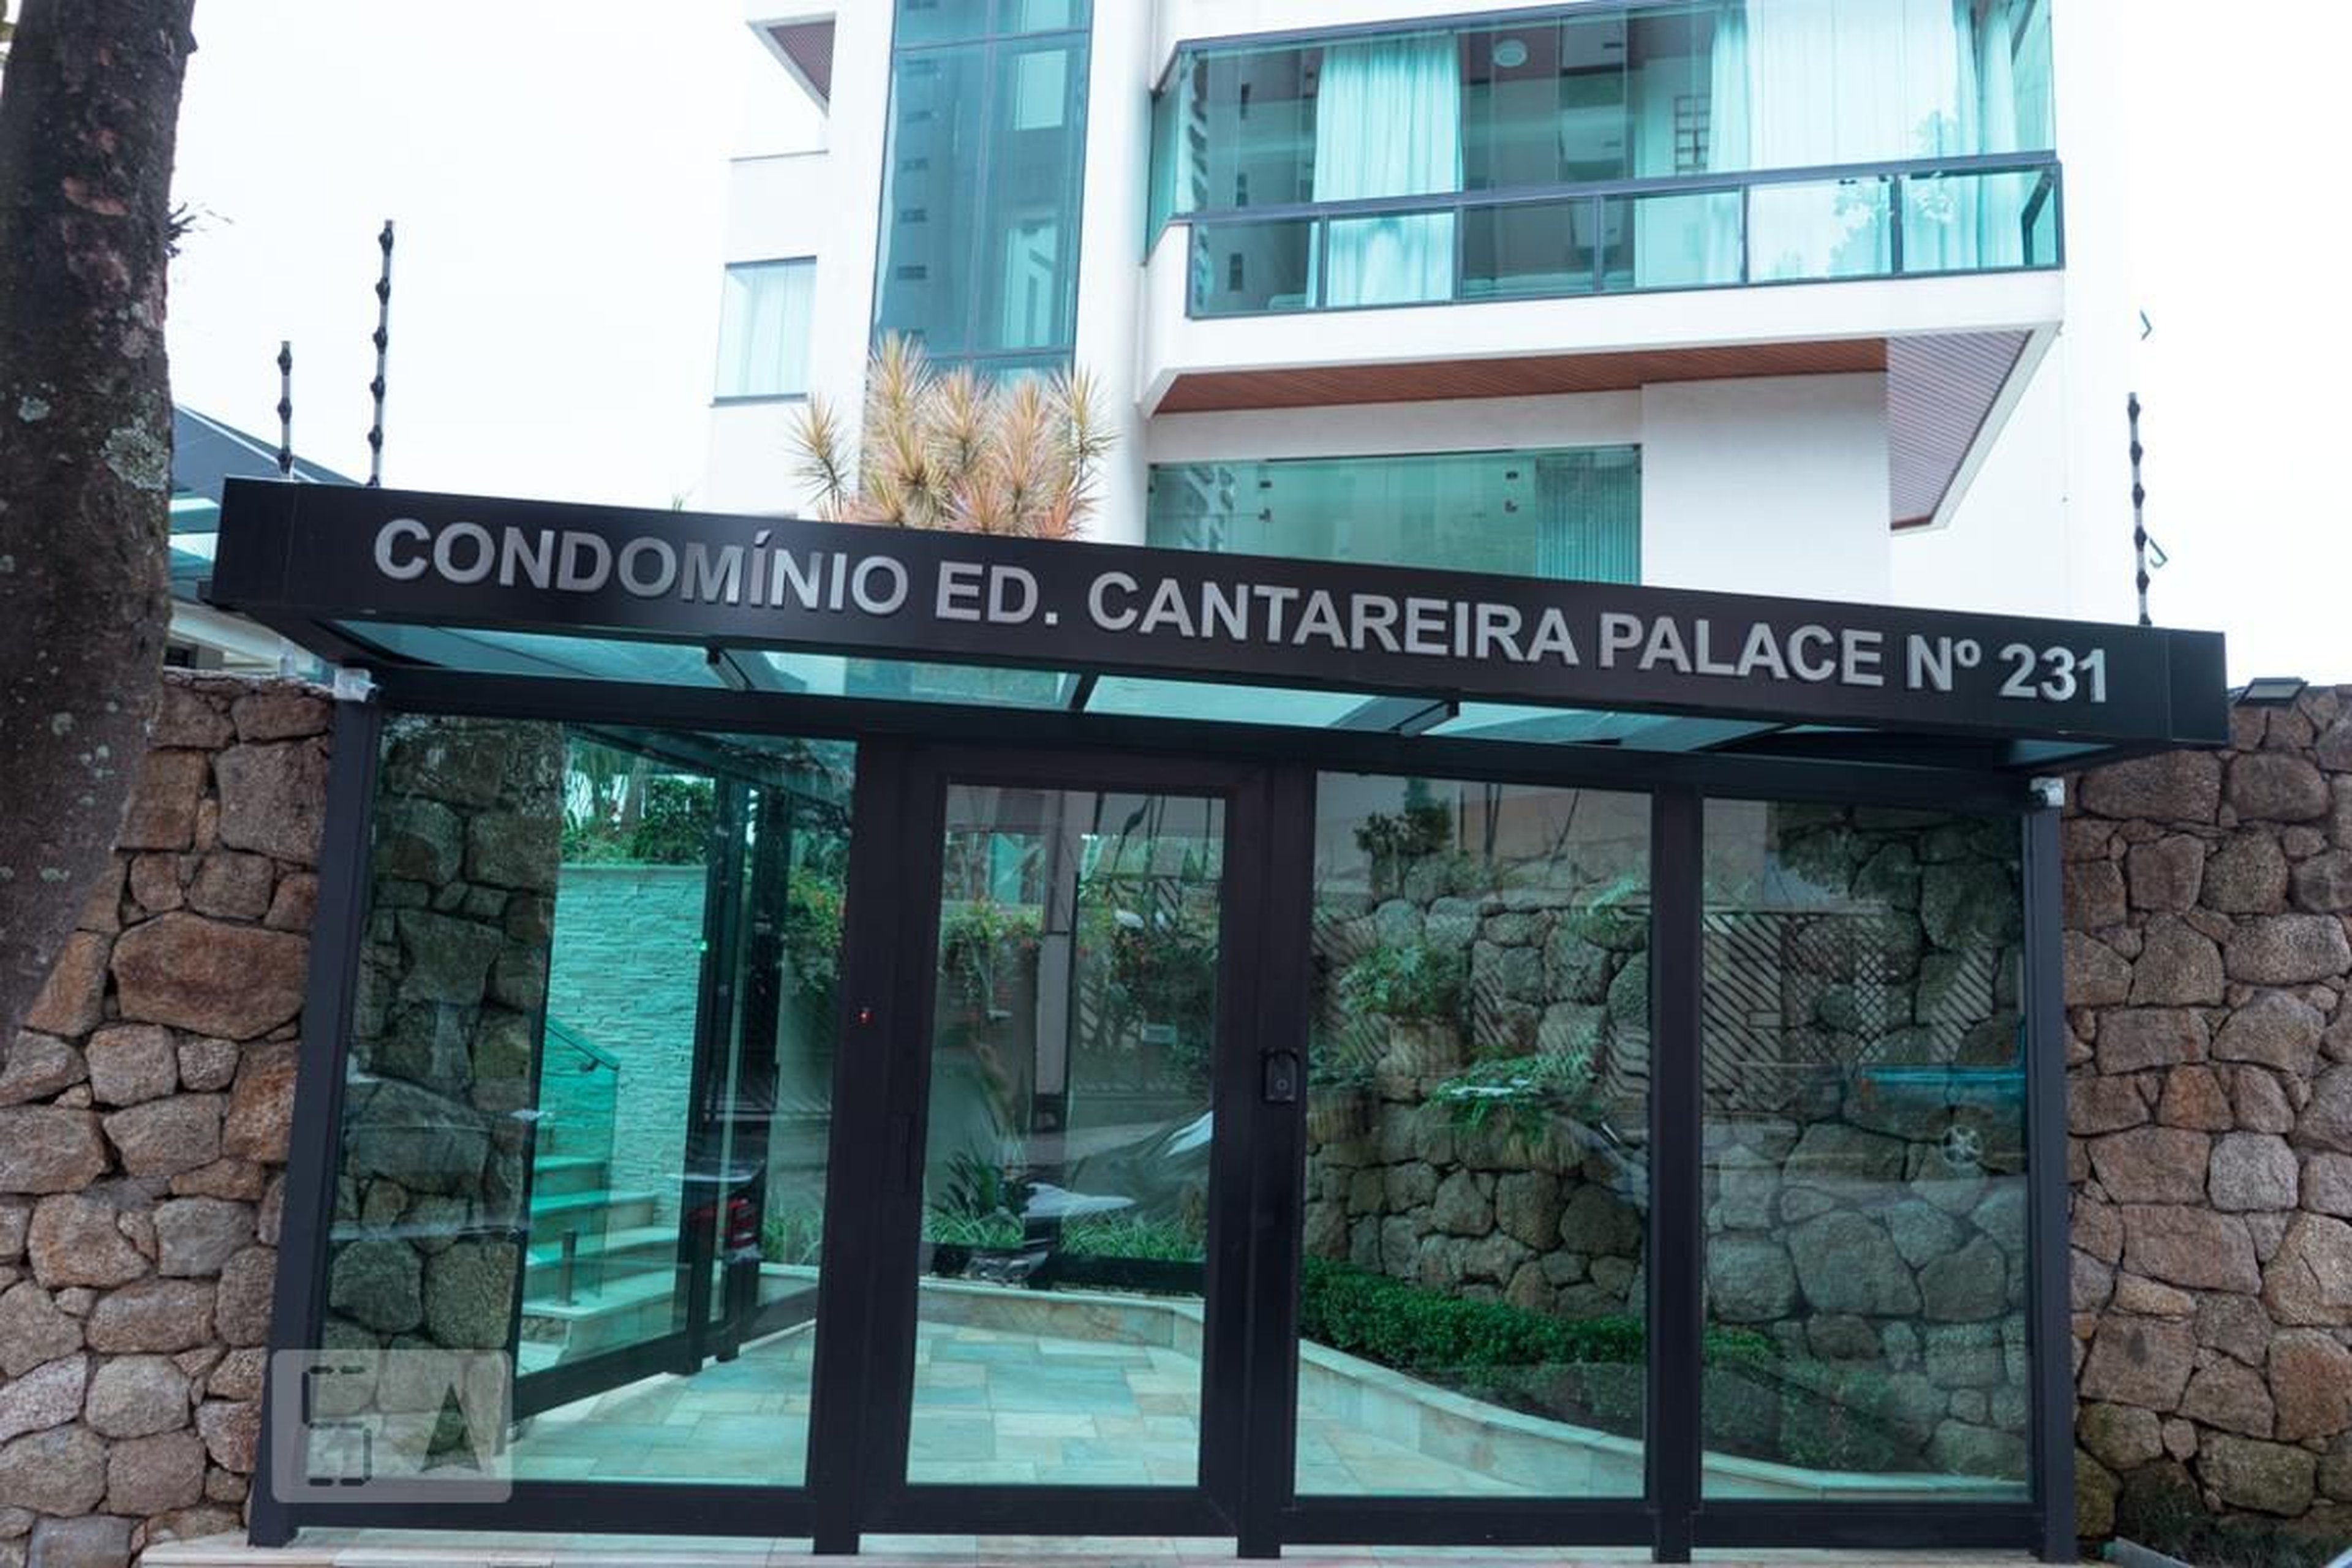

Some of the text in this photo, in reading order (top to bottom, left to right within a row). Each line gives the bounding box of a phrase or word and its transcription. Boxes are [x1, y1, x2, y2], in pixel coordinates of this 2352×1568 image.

[374, 518, 909, 614] CONDOMÍNIO
[935, 560, 1058, 625] ED.
[1088, 571, 1580, 666] CANTAREIRA
[1600, 612, 1884, 686] PALACE
[1998, 643, 2106, 703] 231
